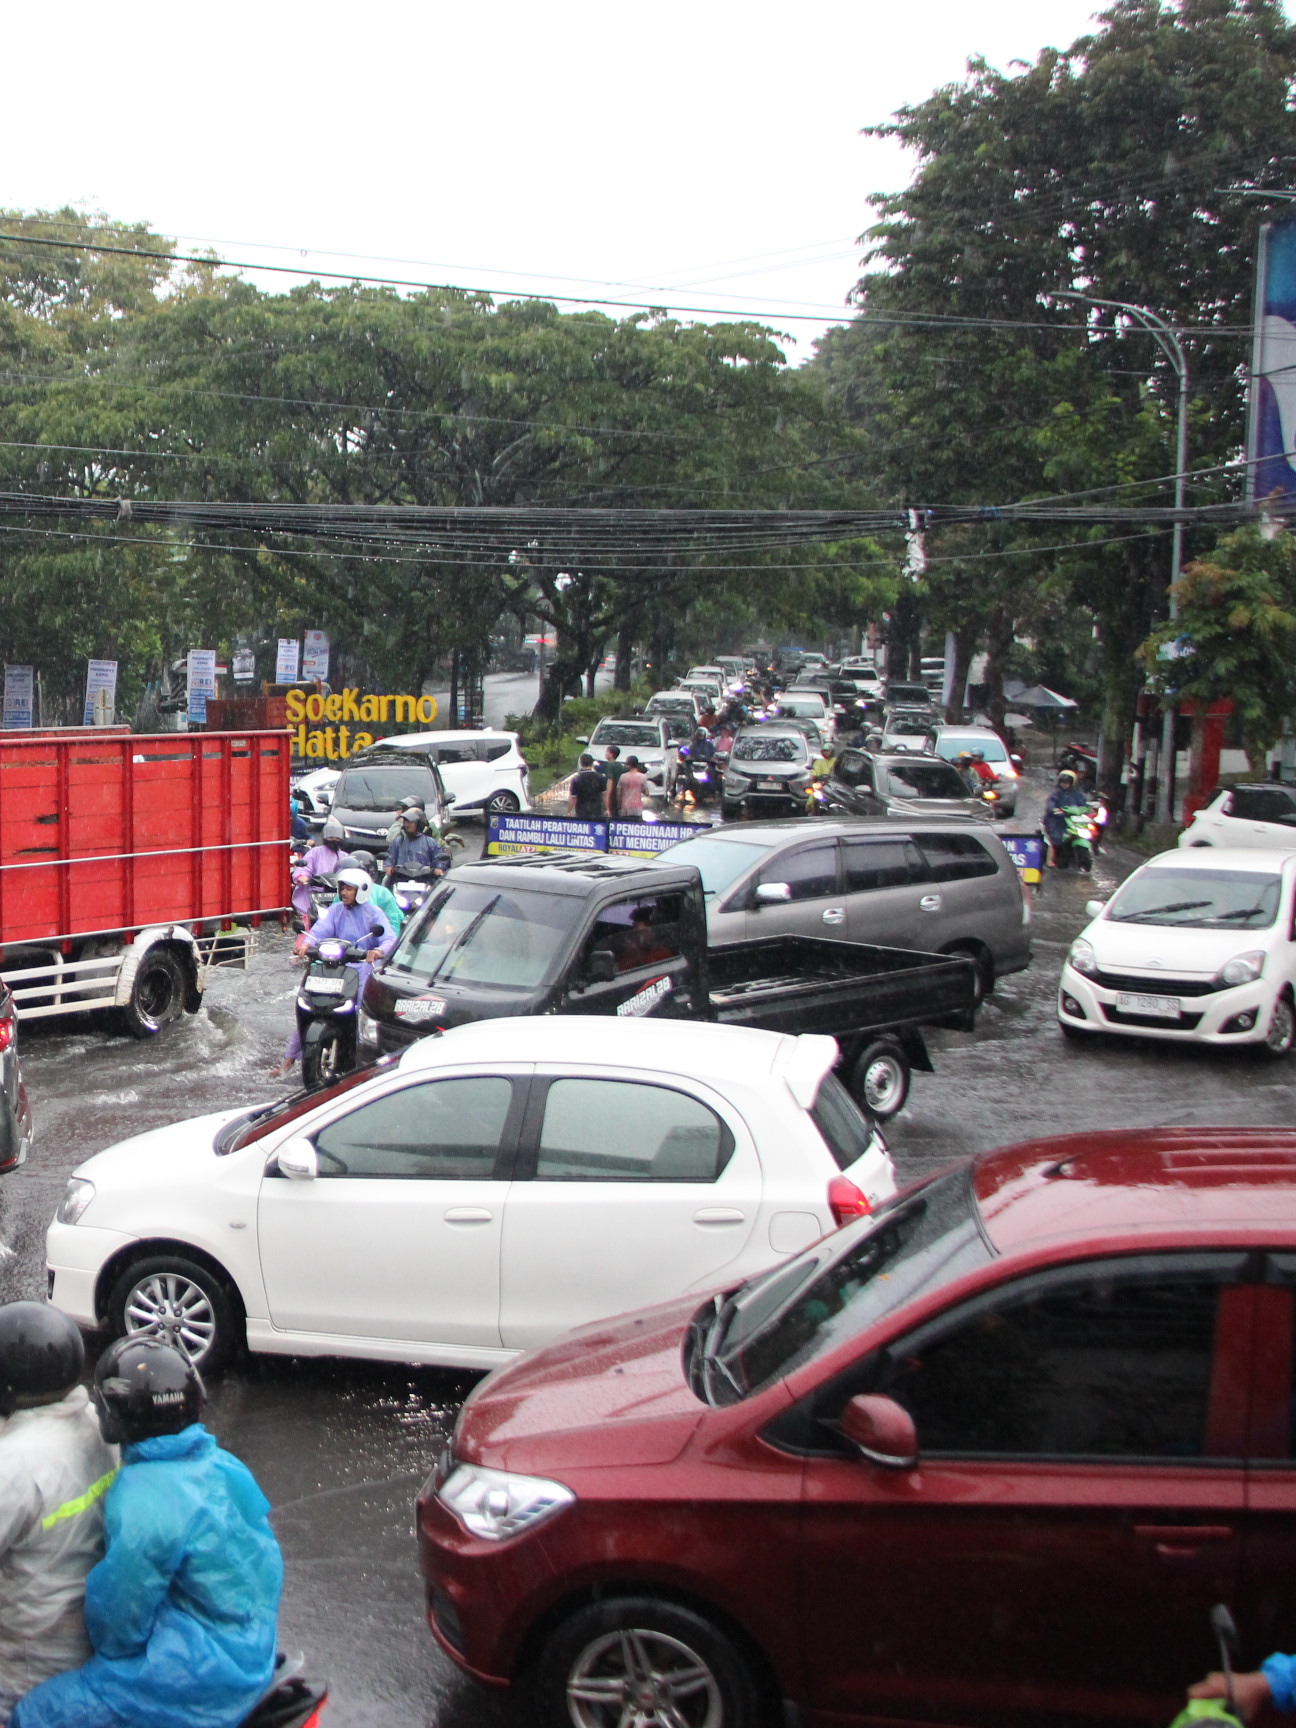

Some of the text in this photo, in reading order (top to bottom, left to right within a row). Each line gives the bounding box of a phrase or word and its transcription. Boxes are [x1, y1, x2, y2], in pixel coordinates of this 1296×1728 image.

[505, 818, 590, 835] TAATILAH PERATURAN
[616, 823, 678, 839] PENGGUNAAN
[679, 827, 694, 839] HP
[499, 829, 515, 842] DAN
[516, 831, 544, 844] RAMBU
[545, 833, 566, 846] LALU
[151, 1391, 185, 1405] YAMAHA
